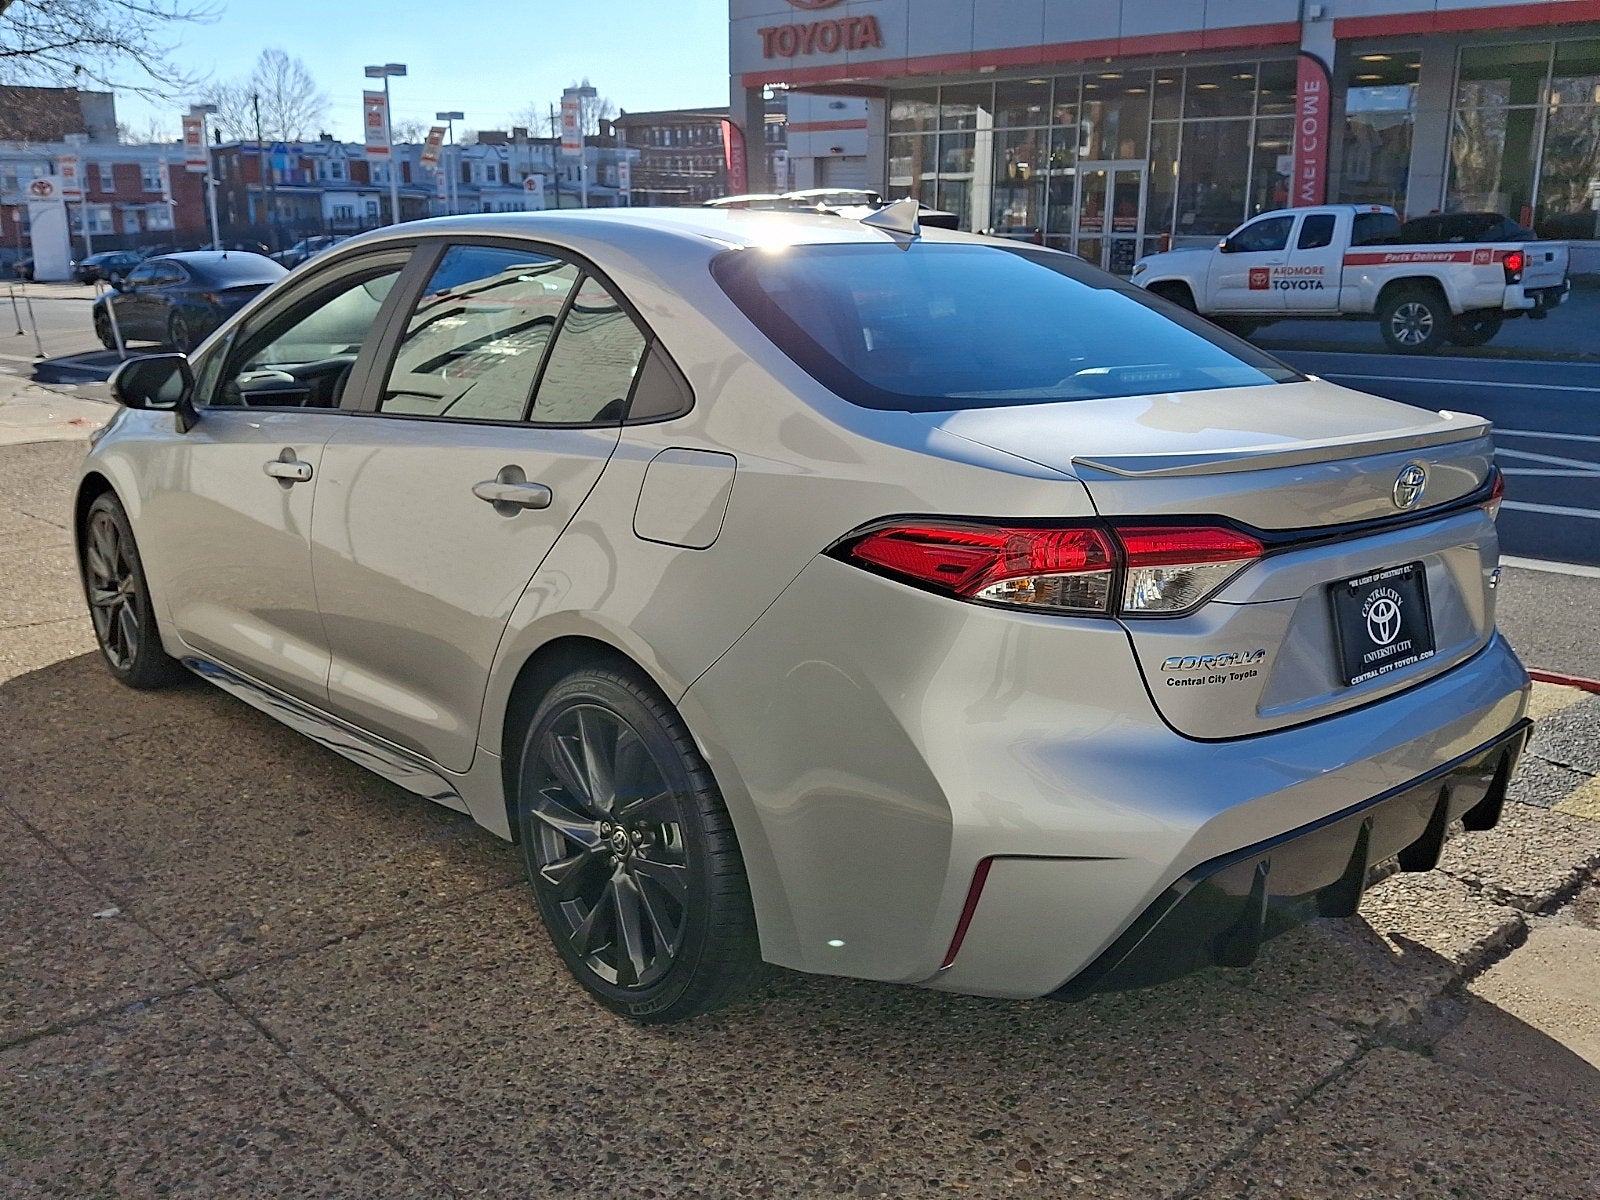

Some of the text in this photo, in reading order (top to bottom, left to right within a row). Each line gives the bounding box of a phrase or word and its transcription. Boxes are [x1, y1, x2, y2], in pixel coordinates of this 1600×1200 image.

[757, 15, 881, 59] TOYOTA
[1384, 252, 1456, 262] Parts Delivery
[1273, 266, 1325, 275] ARDMORE
[1273, 280, 1324, 290] TOYOTA
[1362, 587, 1403, 617] CENTRAL CITY
[1160, 648, 1265, 671] COROLLA
[1364, 640, 1412, 663] UNIVERSITY CITY
[1166, 669, 1258, 687] Central City Toyota
[1351, 670, 1379, 685] CENTRAL
[1380, 664, 1393, 674] CITY
[1394, 655, 1419, 669] TOYOTA
